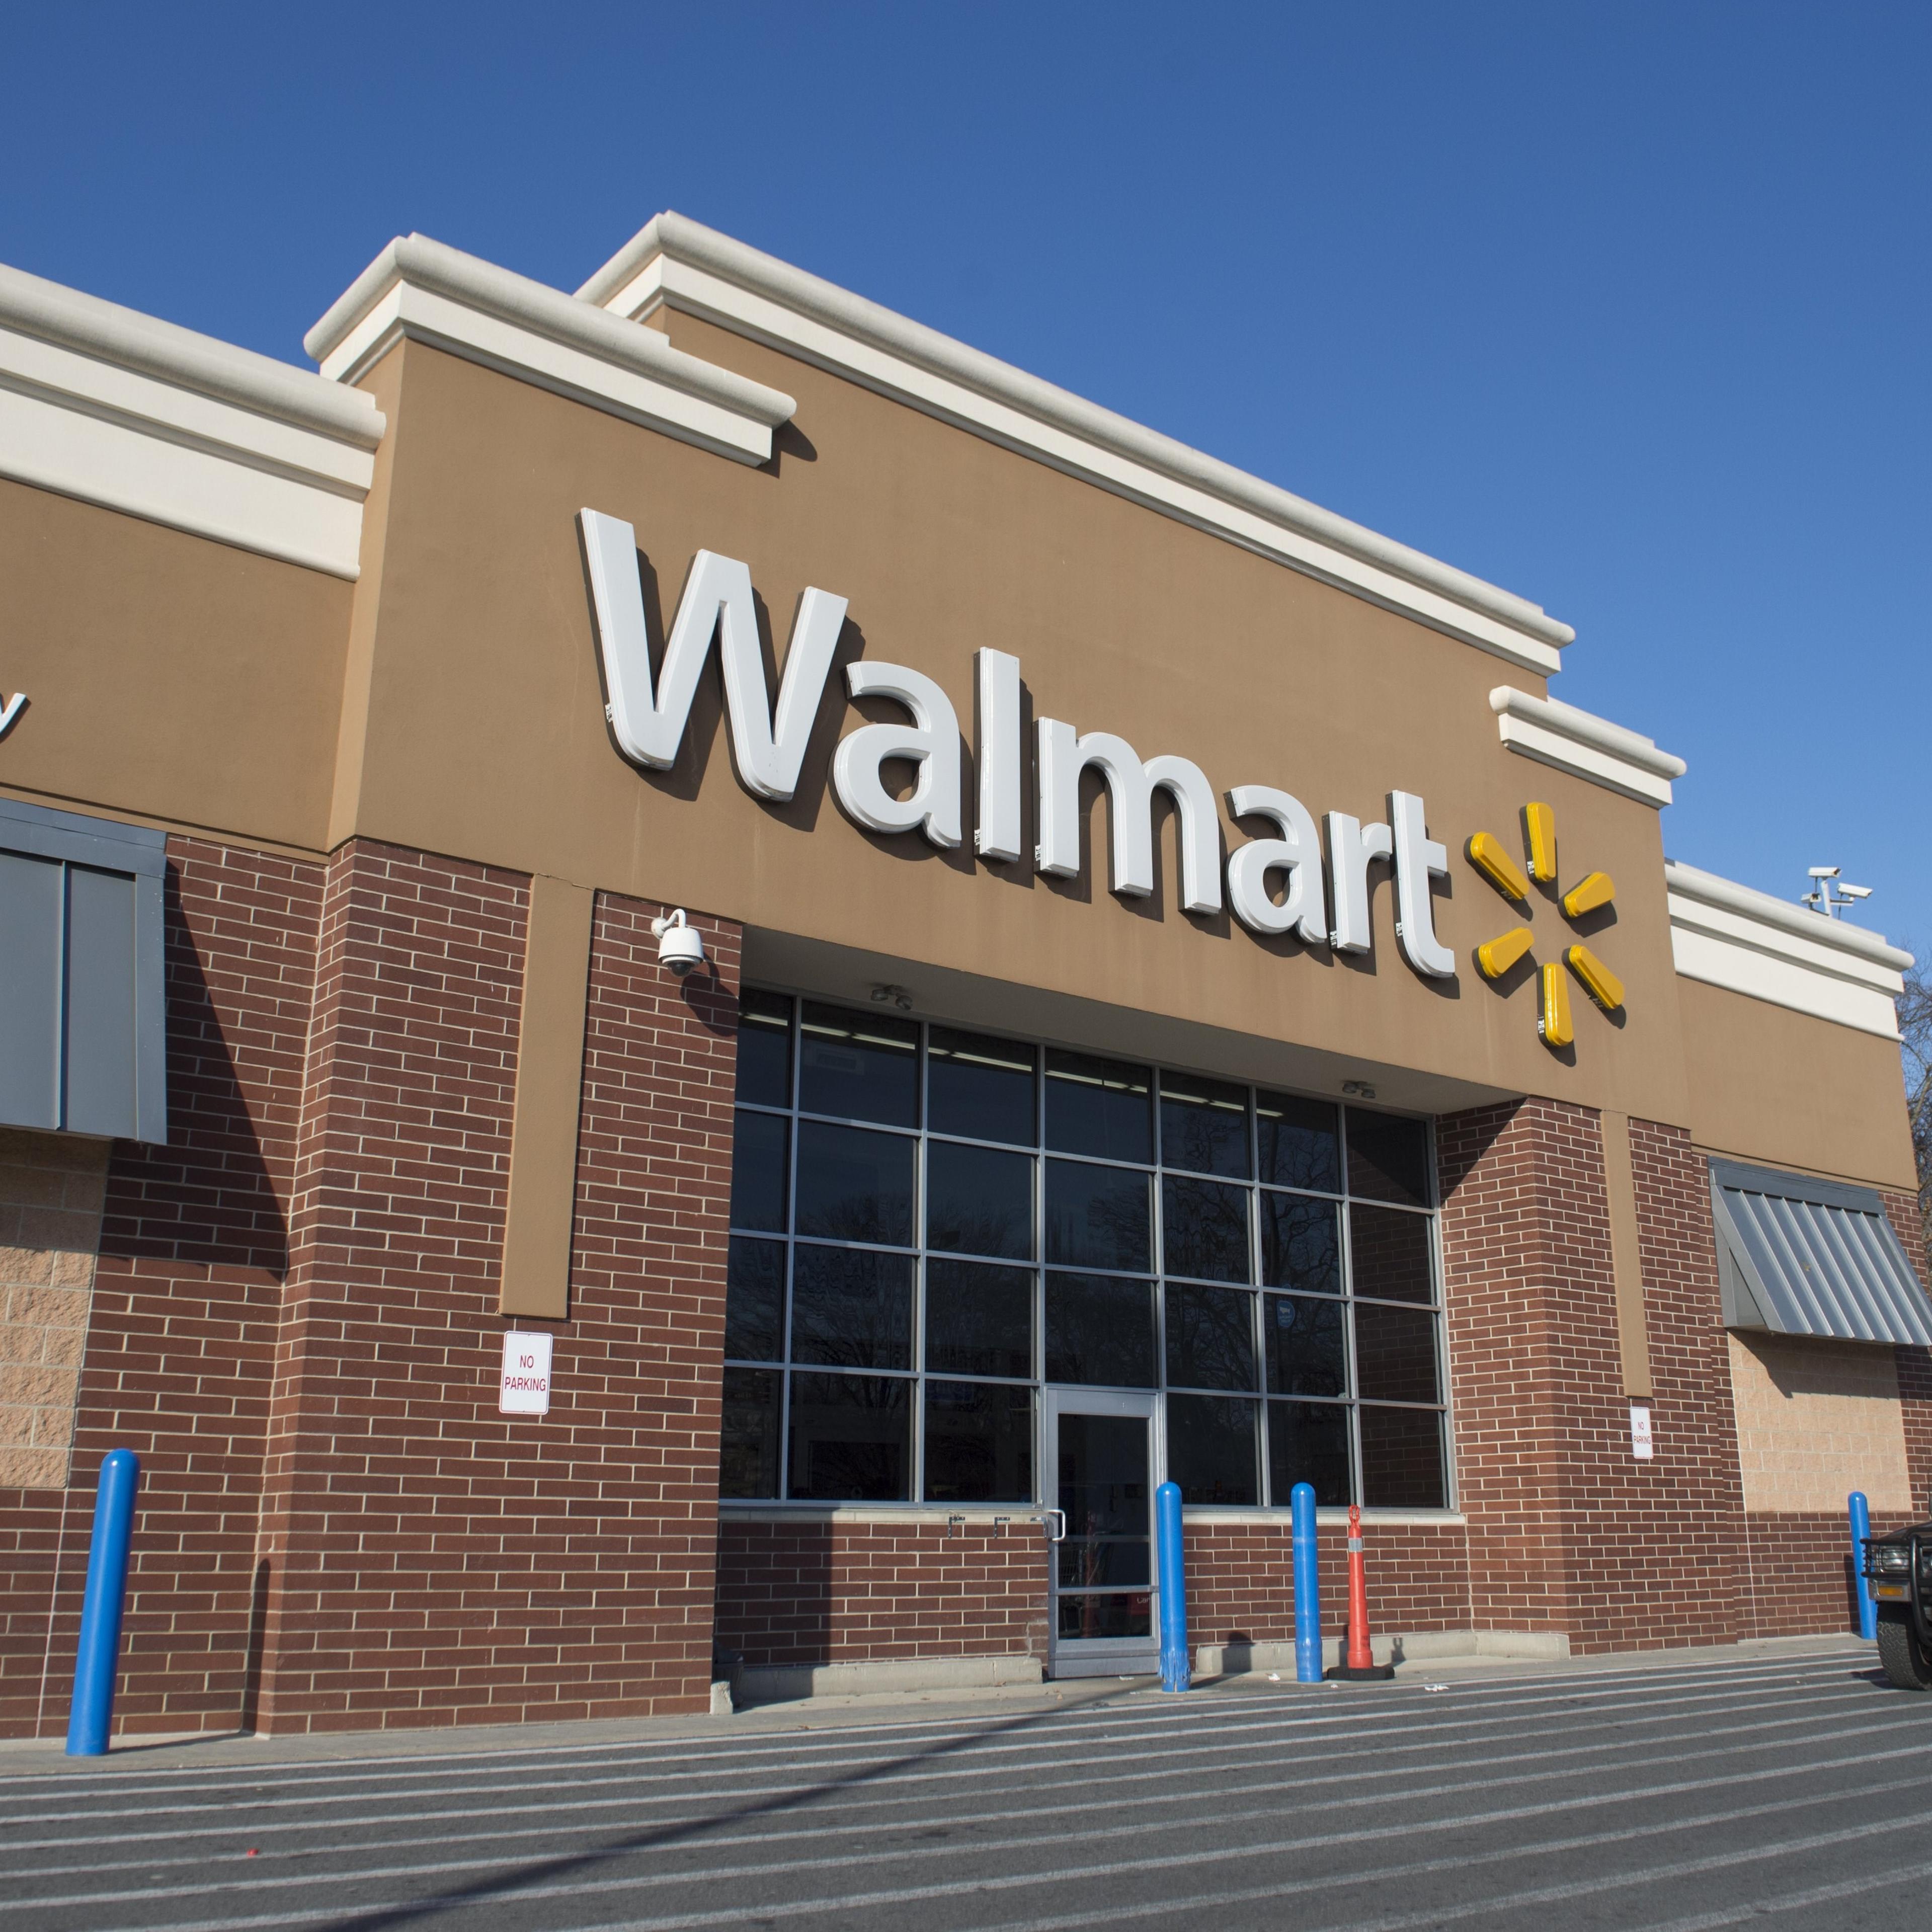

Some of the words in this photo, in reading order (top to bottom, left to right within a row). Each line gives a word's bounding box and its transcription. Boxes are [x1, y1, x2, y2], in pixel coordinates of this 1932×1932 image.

[578, 506, 1455, 979] Walmart
[520, 1355, 534, 1369] NO
[505, 1377, 546, 1391] PARKING
[1638, 1421, 1644, 1430] NO
[1634, 1435, 1651, 1444] PARKING
